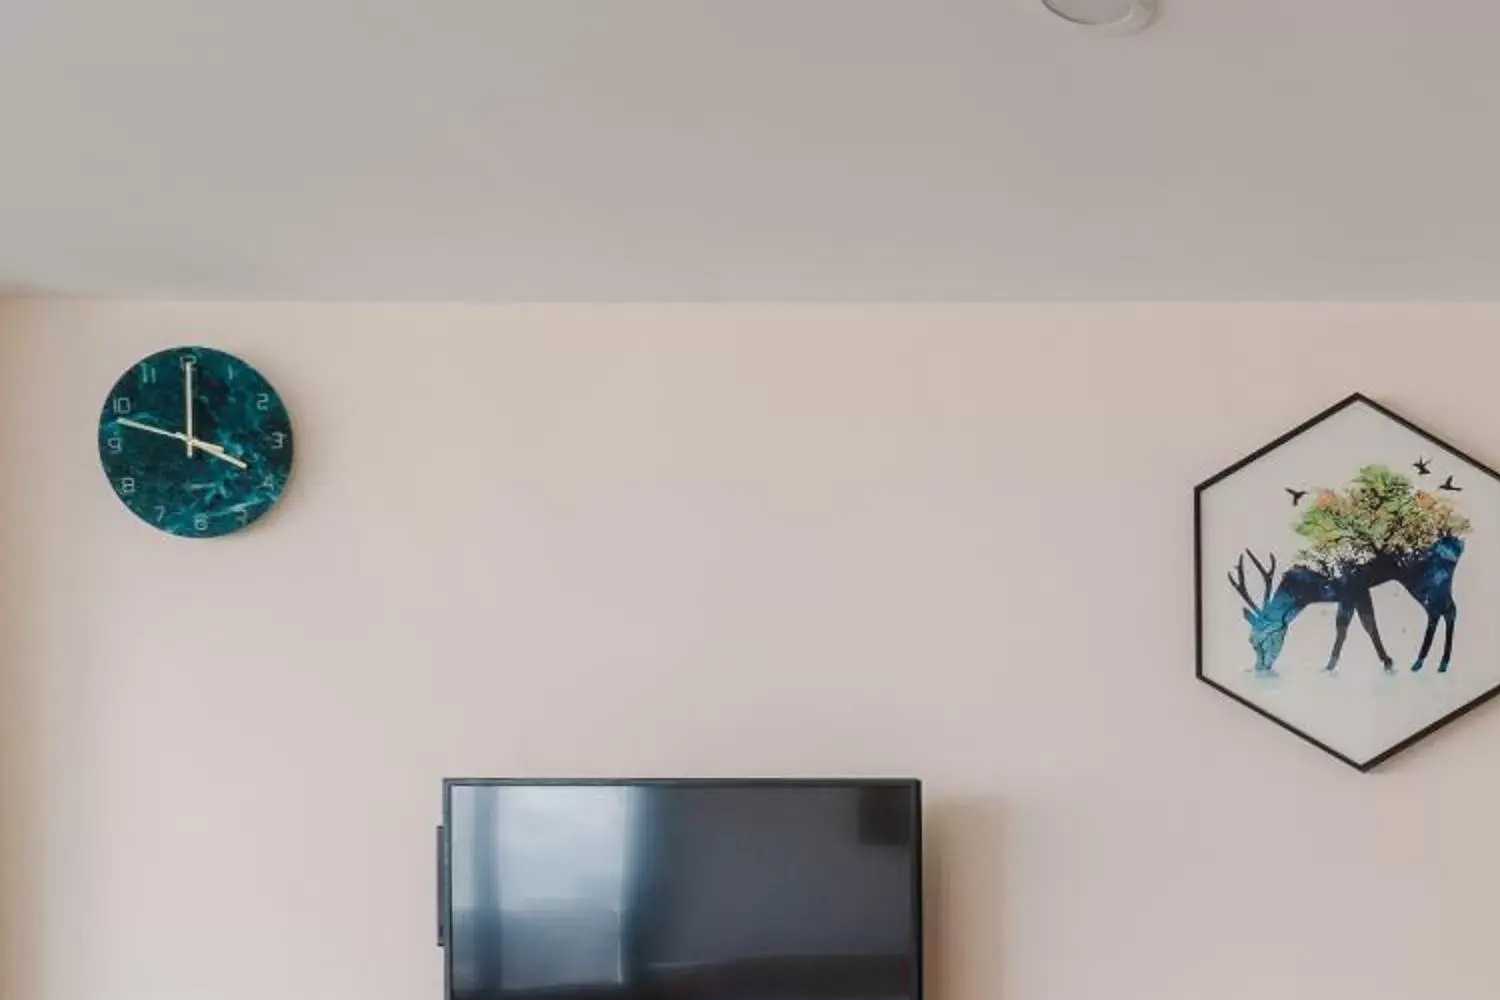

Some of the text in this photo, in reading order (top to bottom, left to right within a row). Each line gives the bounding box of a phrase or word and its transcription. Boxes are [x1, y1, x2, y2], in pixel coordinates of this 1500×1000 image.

[140, 362, 156, 383] 11
[113, 397, 130, 413] 10
[256, 393, 269, 411] 2
[108, 437, 121, 453] 9
[272, 432, 285, 449] 3
[122, 478, 135, 493] 8
[154, 505, 166, 522] 7
[194, 514, 208, 531] 6
